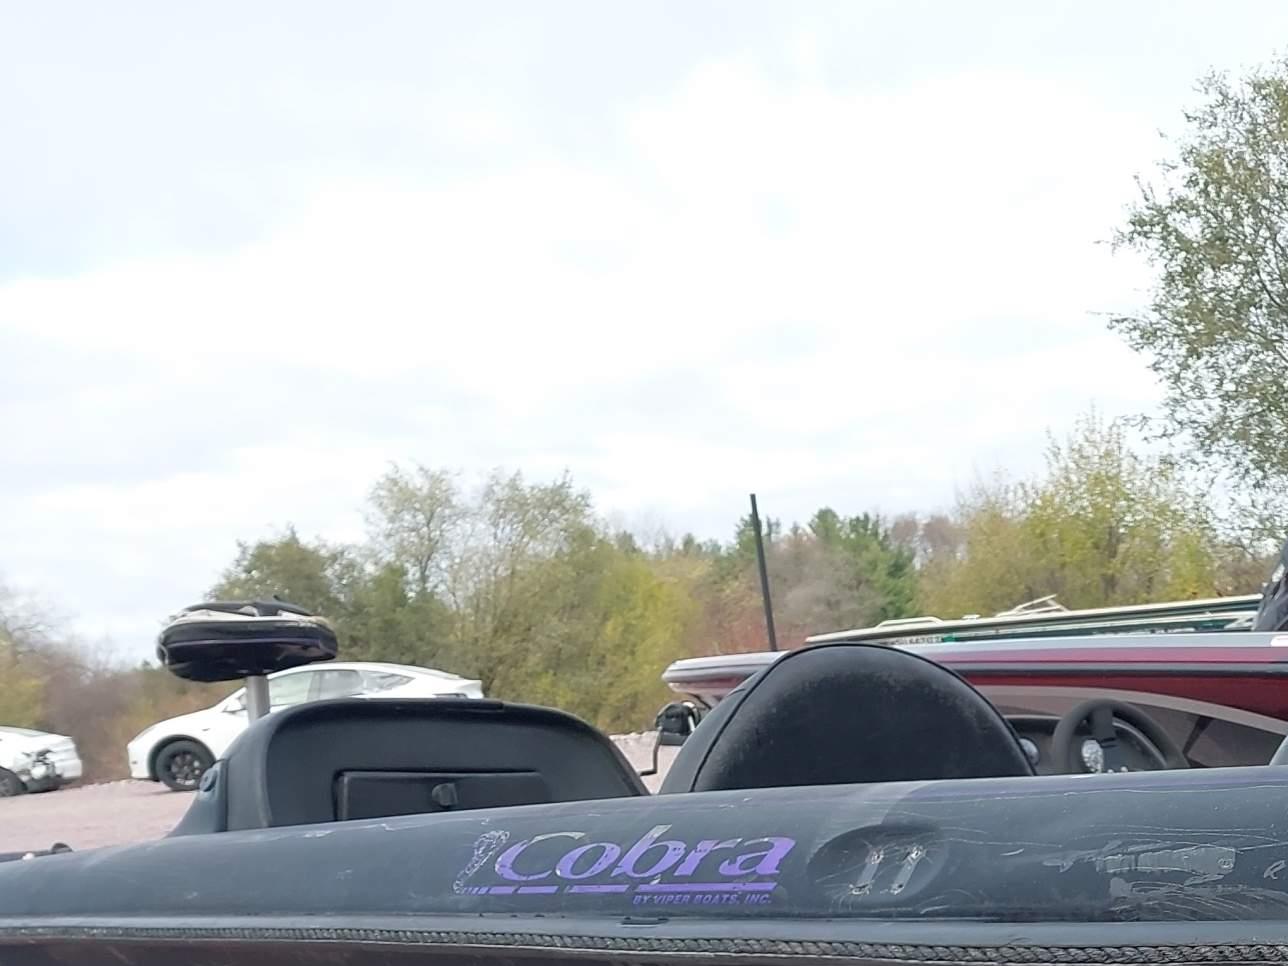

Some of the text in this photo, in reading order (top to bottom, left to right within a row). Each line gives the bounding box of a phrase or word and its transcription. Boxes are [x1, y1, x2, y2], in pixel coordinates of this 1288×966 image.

[495, 824, 796, 881] Cobra
[633, 894, 650, 905] BY
[654, 893, 690, 905] VIPER
[744, 893, 772, 904] INC.
